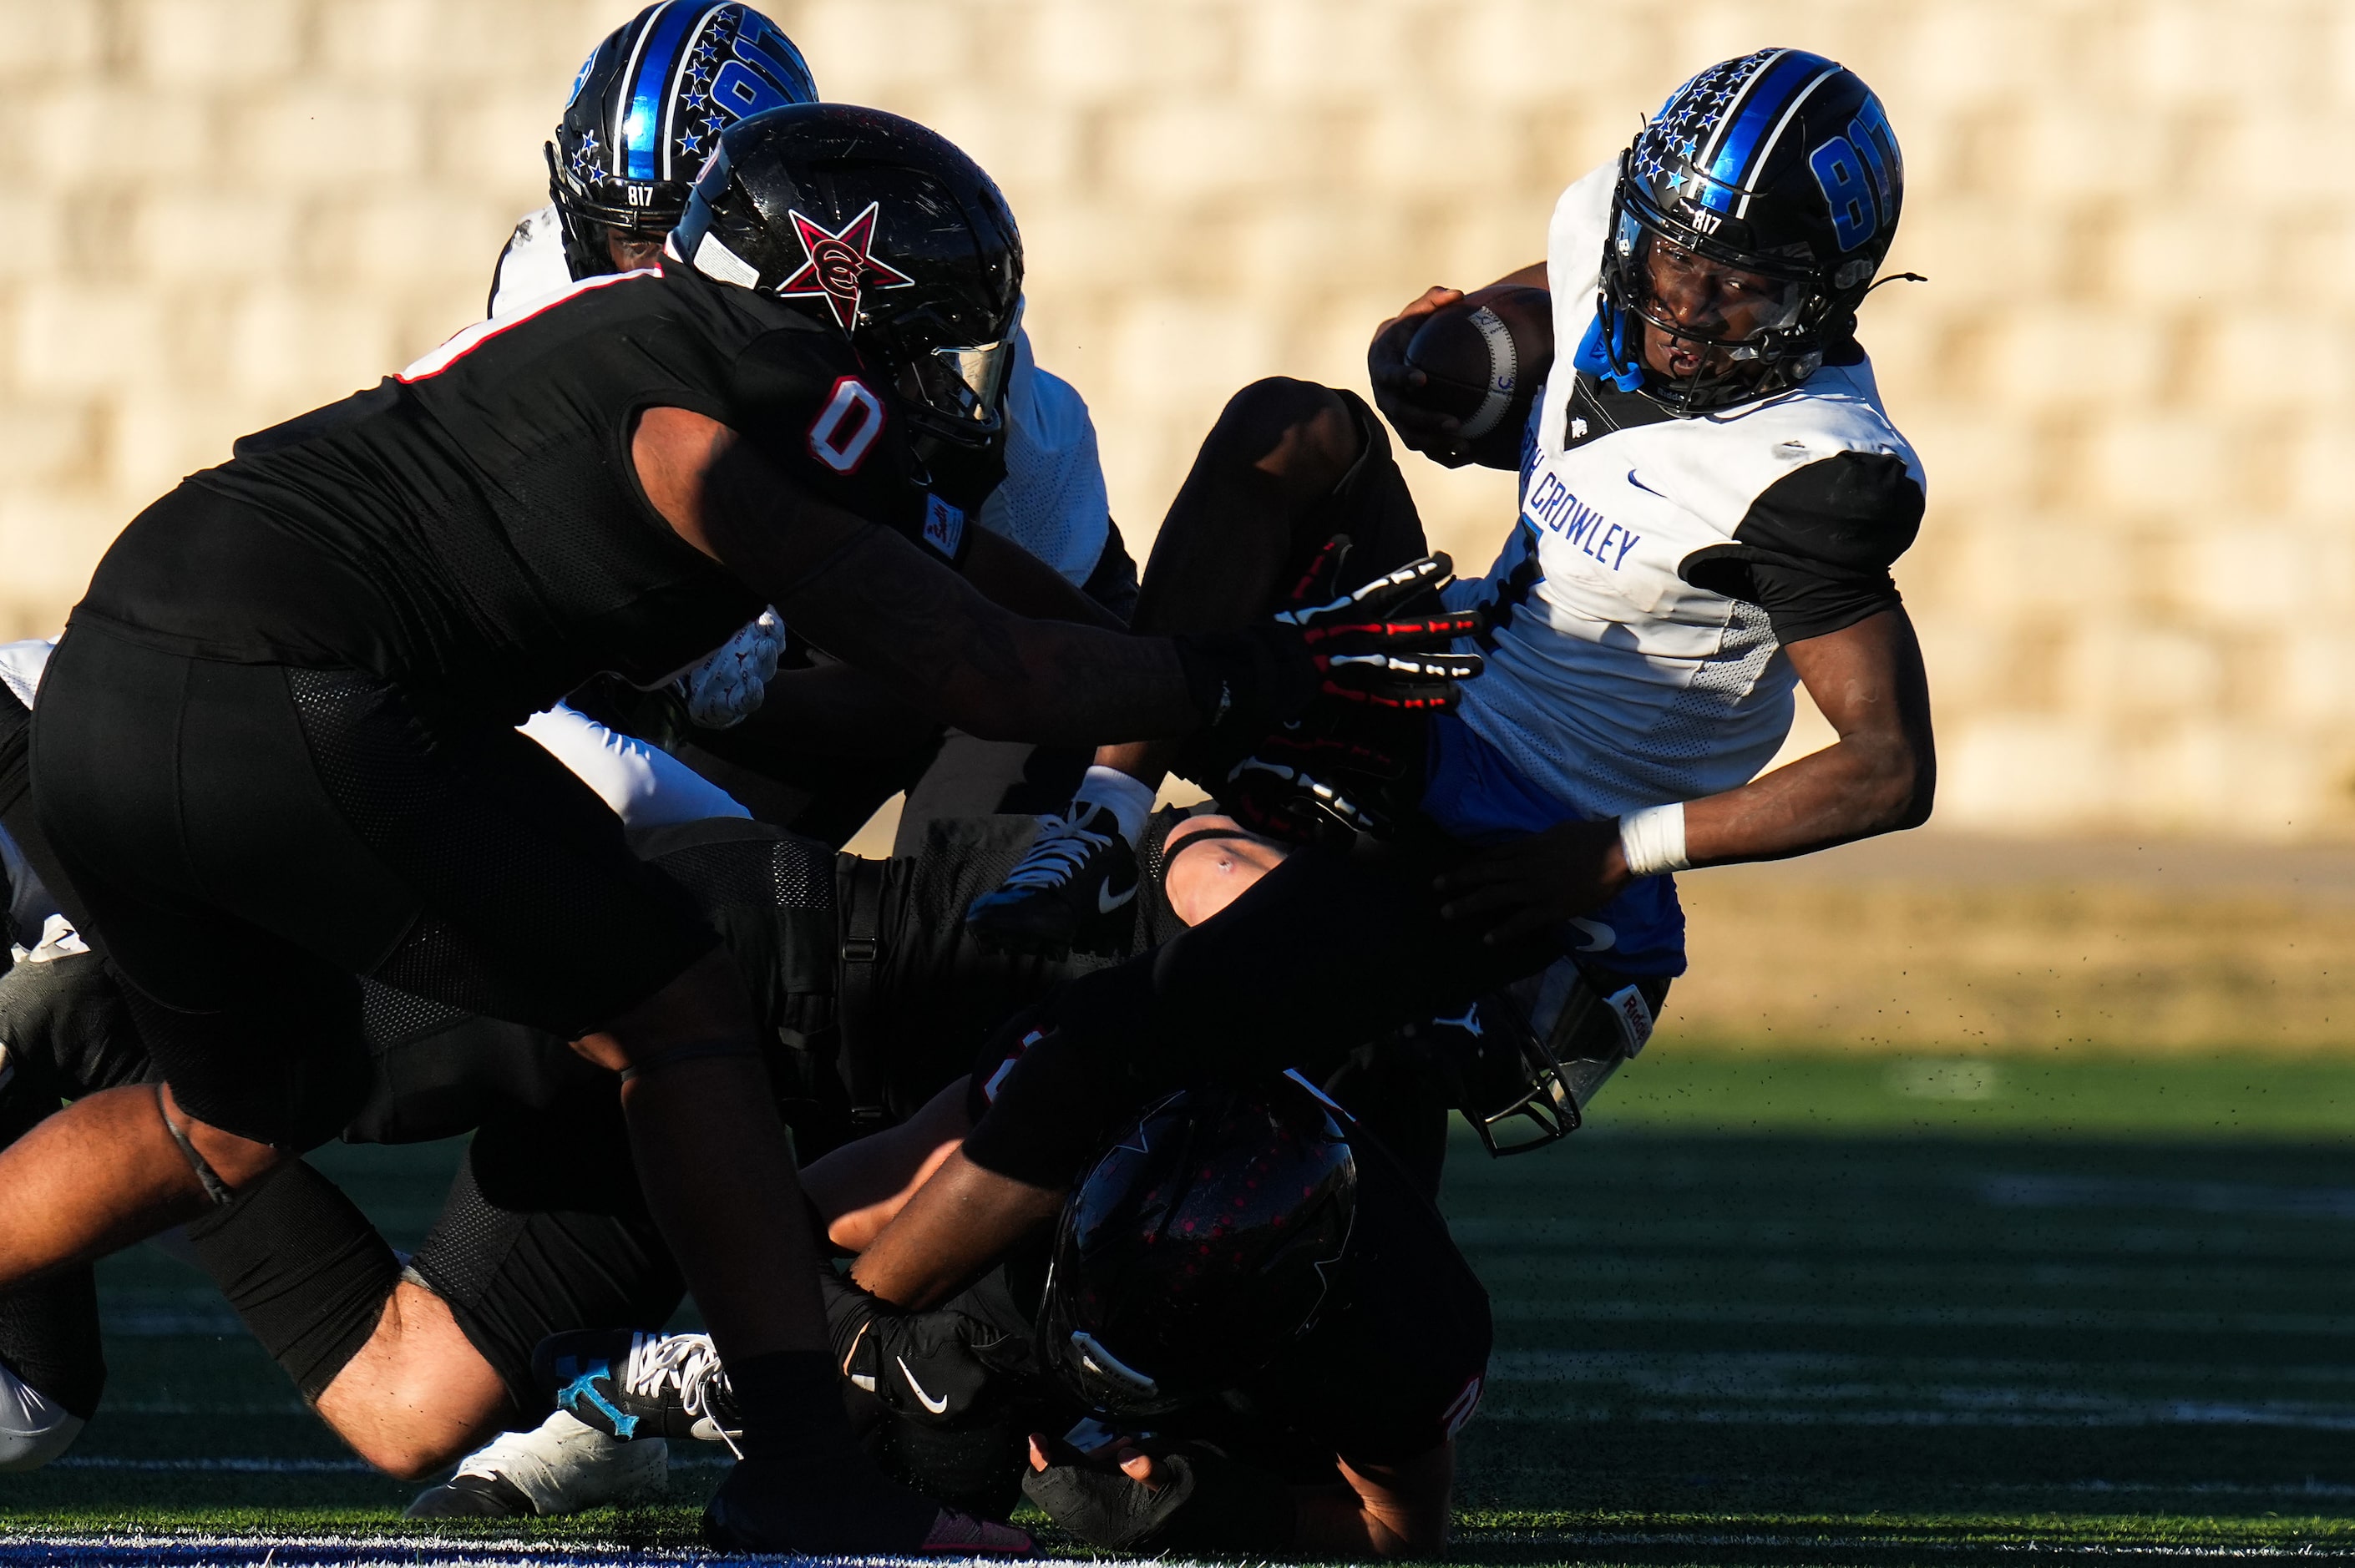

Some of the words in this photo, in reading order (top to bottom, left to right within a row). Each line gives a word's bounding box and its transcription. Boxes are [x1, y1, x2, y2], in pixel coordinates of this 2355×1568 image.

[628, 186, 653, 206] 817
[1692, 209, 1722, 235] 817
[1809, 92, 1904, 253] 817
[805, 374, 889, 476] 0
[1530, 471, 1640, 571] CROWLEY
